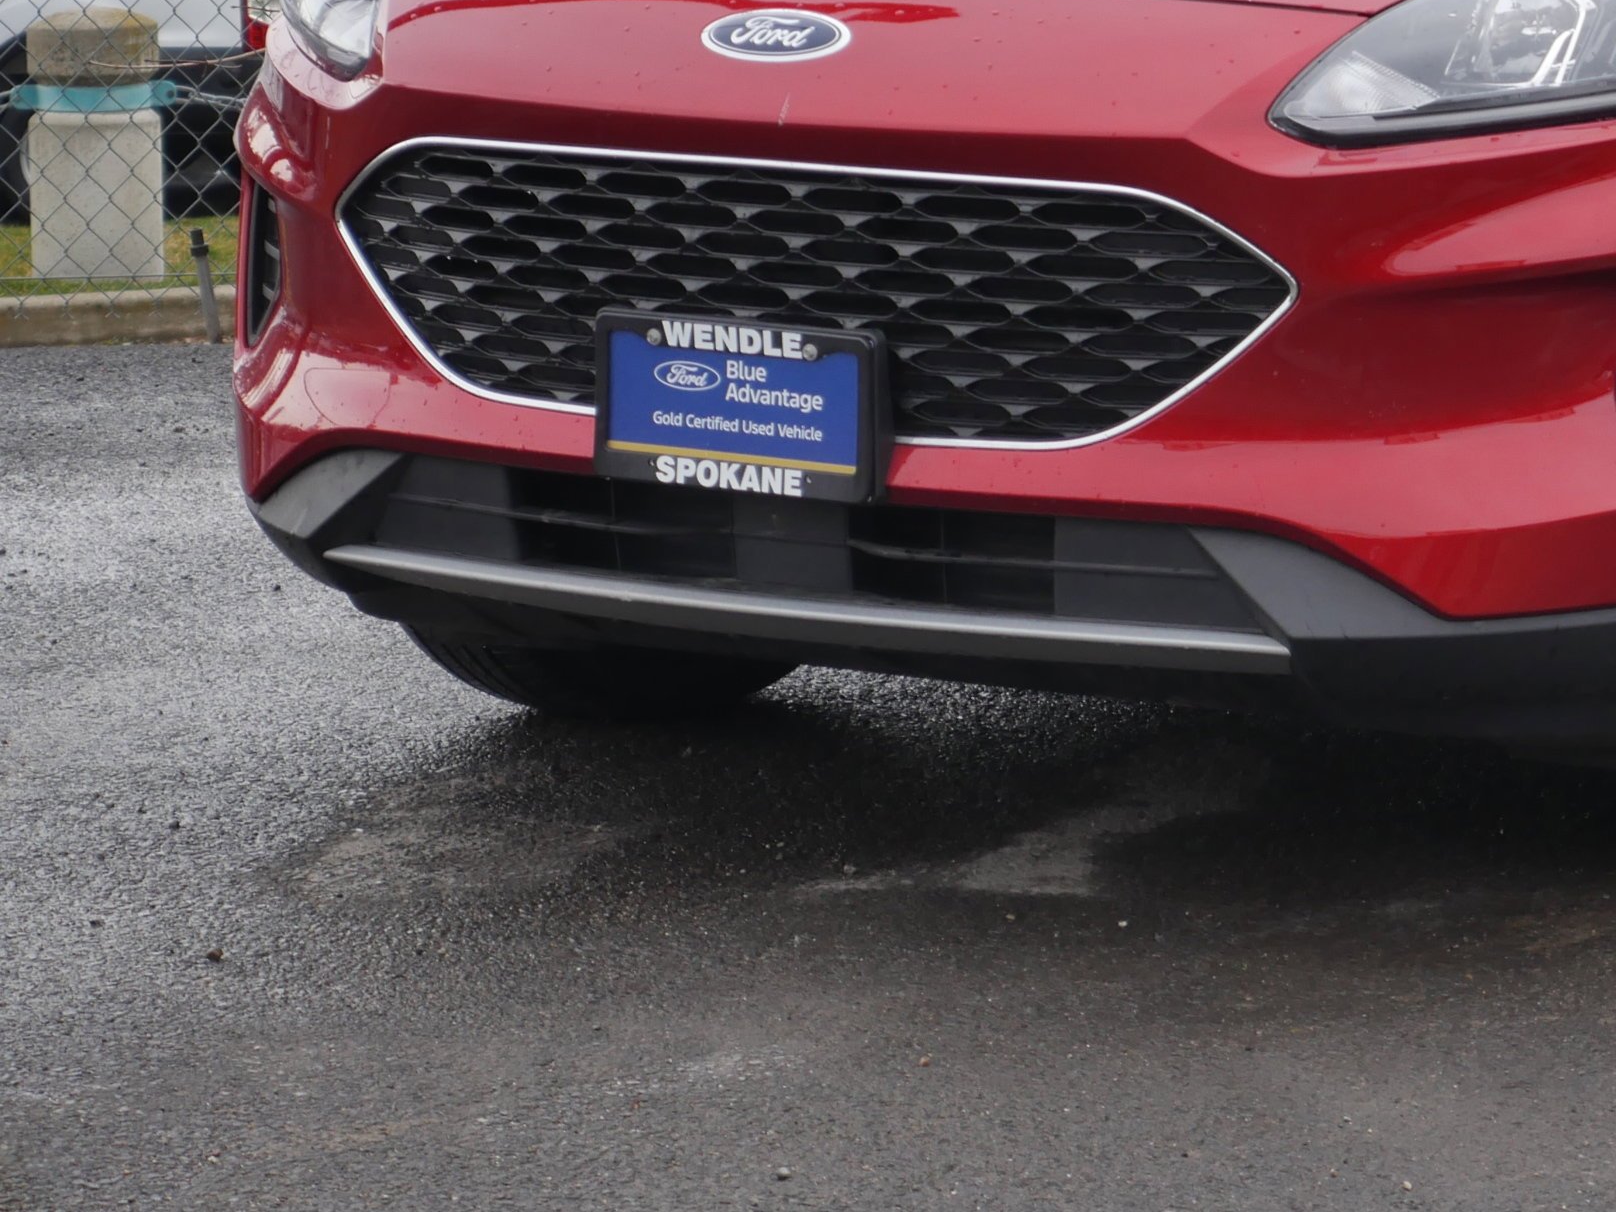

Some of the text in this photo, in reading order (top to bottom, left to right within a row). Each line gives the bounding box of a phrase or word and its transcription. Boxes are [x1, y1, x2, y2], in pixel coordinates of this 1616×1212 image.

[731, 16, 815, 49] Ford
[662, 320, 804, 360] WENDLE
[665, 362, 709, 388] Ford
[725, 359, 768, 383] Blue
[725, 383, 824, 414] Advantage
[652, 410, 823, 442] Gold Certified Used Vehicle
[655, 455, 803, 498] SPOKANE
